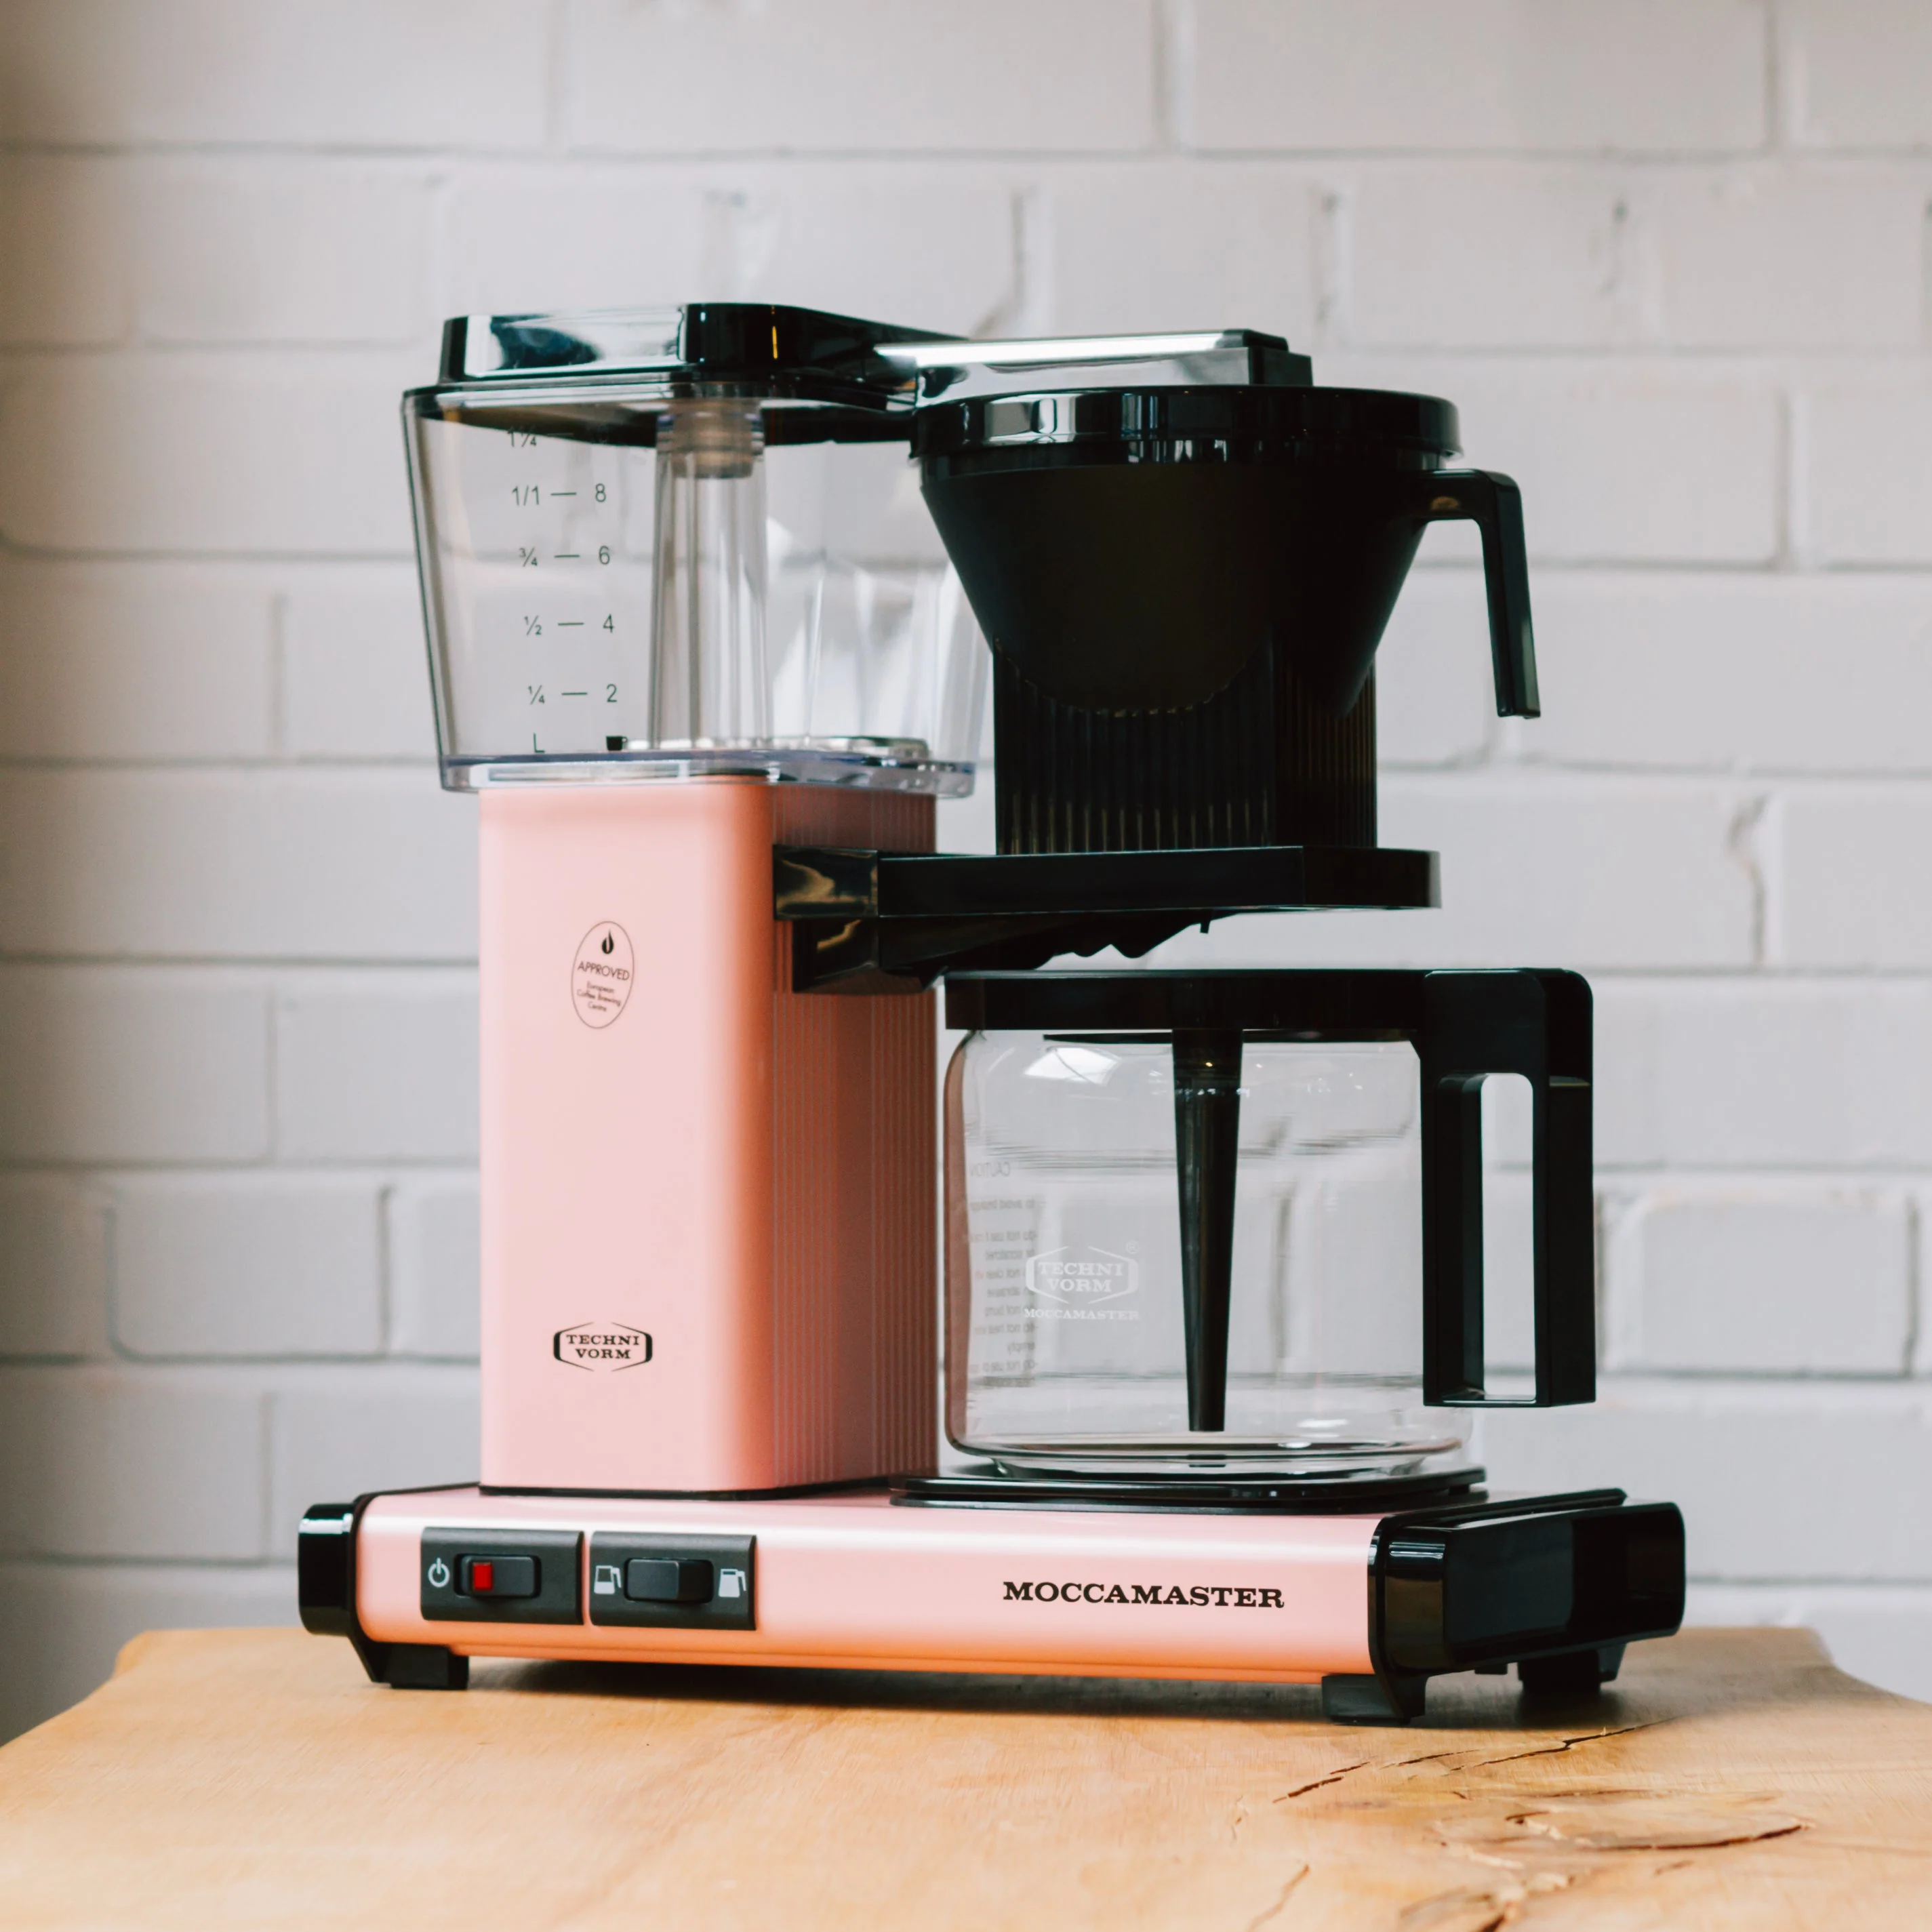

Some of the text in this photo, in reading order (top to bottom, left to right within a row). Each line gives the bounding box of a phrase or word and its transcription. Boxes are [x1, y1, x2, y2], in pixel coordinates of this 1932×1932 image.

[512, 483, 606, 506] 1/1 8
[599, 546, 610, 565] 6
[603, 614, 615, 633] 4
[606, 684, 618, 702] 2
[534, 733, 545, 754] L
[578, 961, 630, 981] APPROVED
[1038, 1262, 1123, 1276] TECHNI
[1047, 1279, 1112, 1292] VORM
[1024, 1308, 1140, 1321] MOCCAMASTER
[566, 1334, 640, 1346] TECHNI
[575, 1348, 630, 1359] VORM
[1003, 1581, 1286, 1609] MOCCAMASTER
